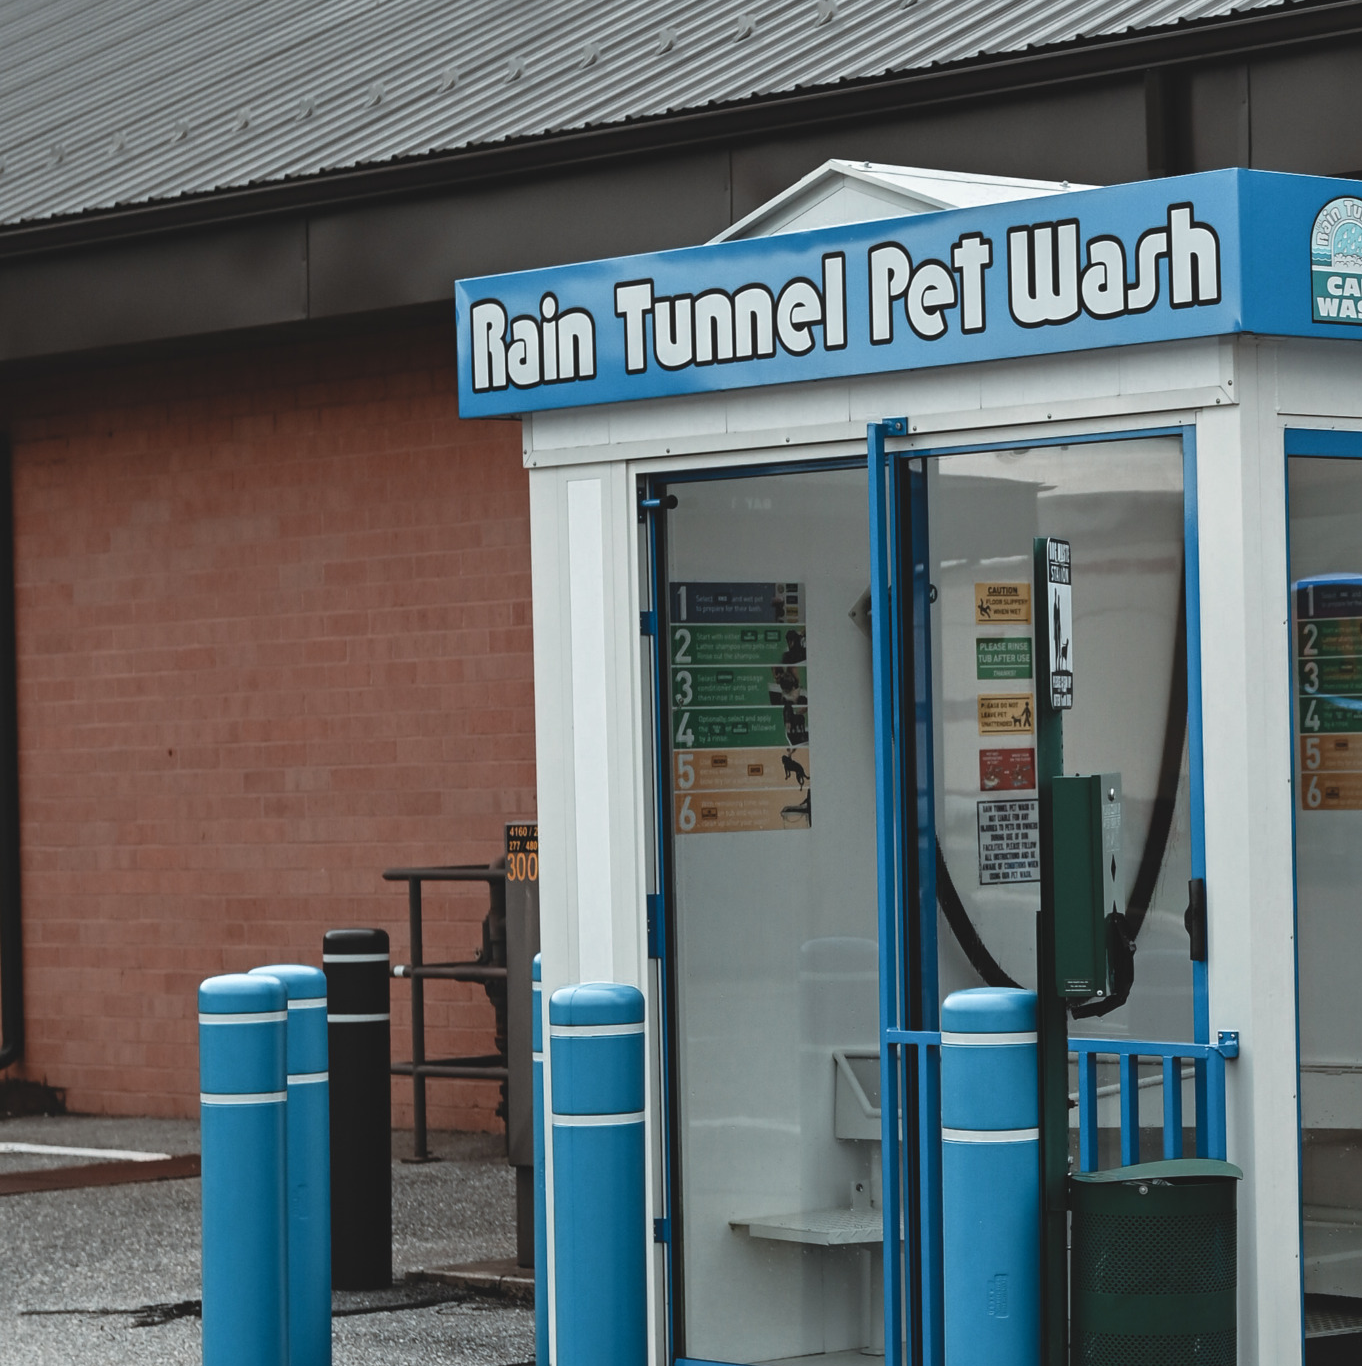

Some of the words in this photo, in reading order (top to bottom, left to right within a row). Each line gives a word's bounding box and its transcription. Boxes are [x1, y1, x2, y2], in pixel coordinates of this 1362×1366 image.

[1316, 206, 1342, 246] Rain
[470, 293, 595, 393] Rain
[614, 252, 847, 375] Tunnel
[868, 233, 992, 346] Pet
[1007, 202, 1221, 328] Wash
[677, 586, 687, 621] 1
[1306, 585, 1314, 617] 1
[674, 629, 691, 663] 2
[980, 643, 1006, 651] PLEASE
[1008, 642, 1028, 650] RINSE
[1303, 624, 1318, 656] 2
[993, 654, 1016, 662] AFTER
[1017, 654, 1030, 662] USE
[675, 671, 692, 705] 3
[1304, 662, 1319, 694] 3
[676, 712, 694, 747] 4
[1304, 699, 1320, 731] 4
[1306, 737, 1320, 770] 5
[678, 753, 694, 789] 5
[1307, 775, 1321, 808] 6
[679, 796, 696, 831] 6
[509, 841, 520, 850] 277
[526, 841, 538, 850] 480
[510, 827, 527, 836] 4160
[507, 853, 538, 881] 300
